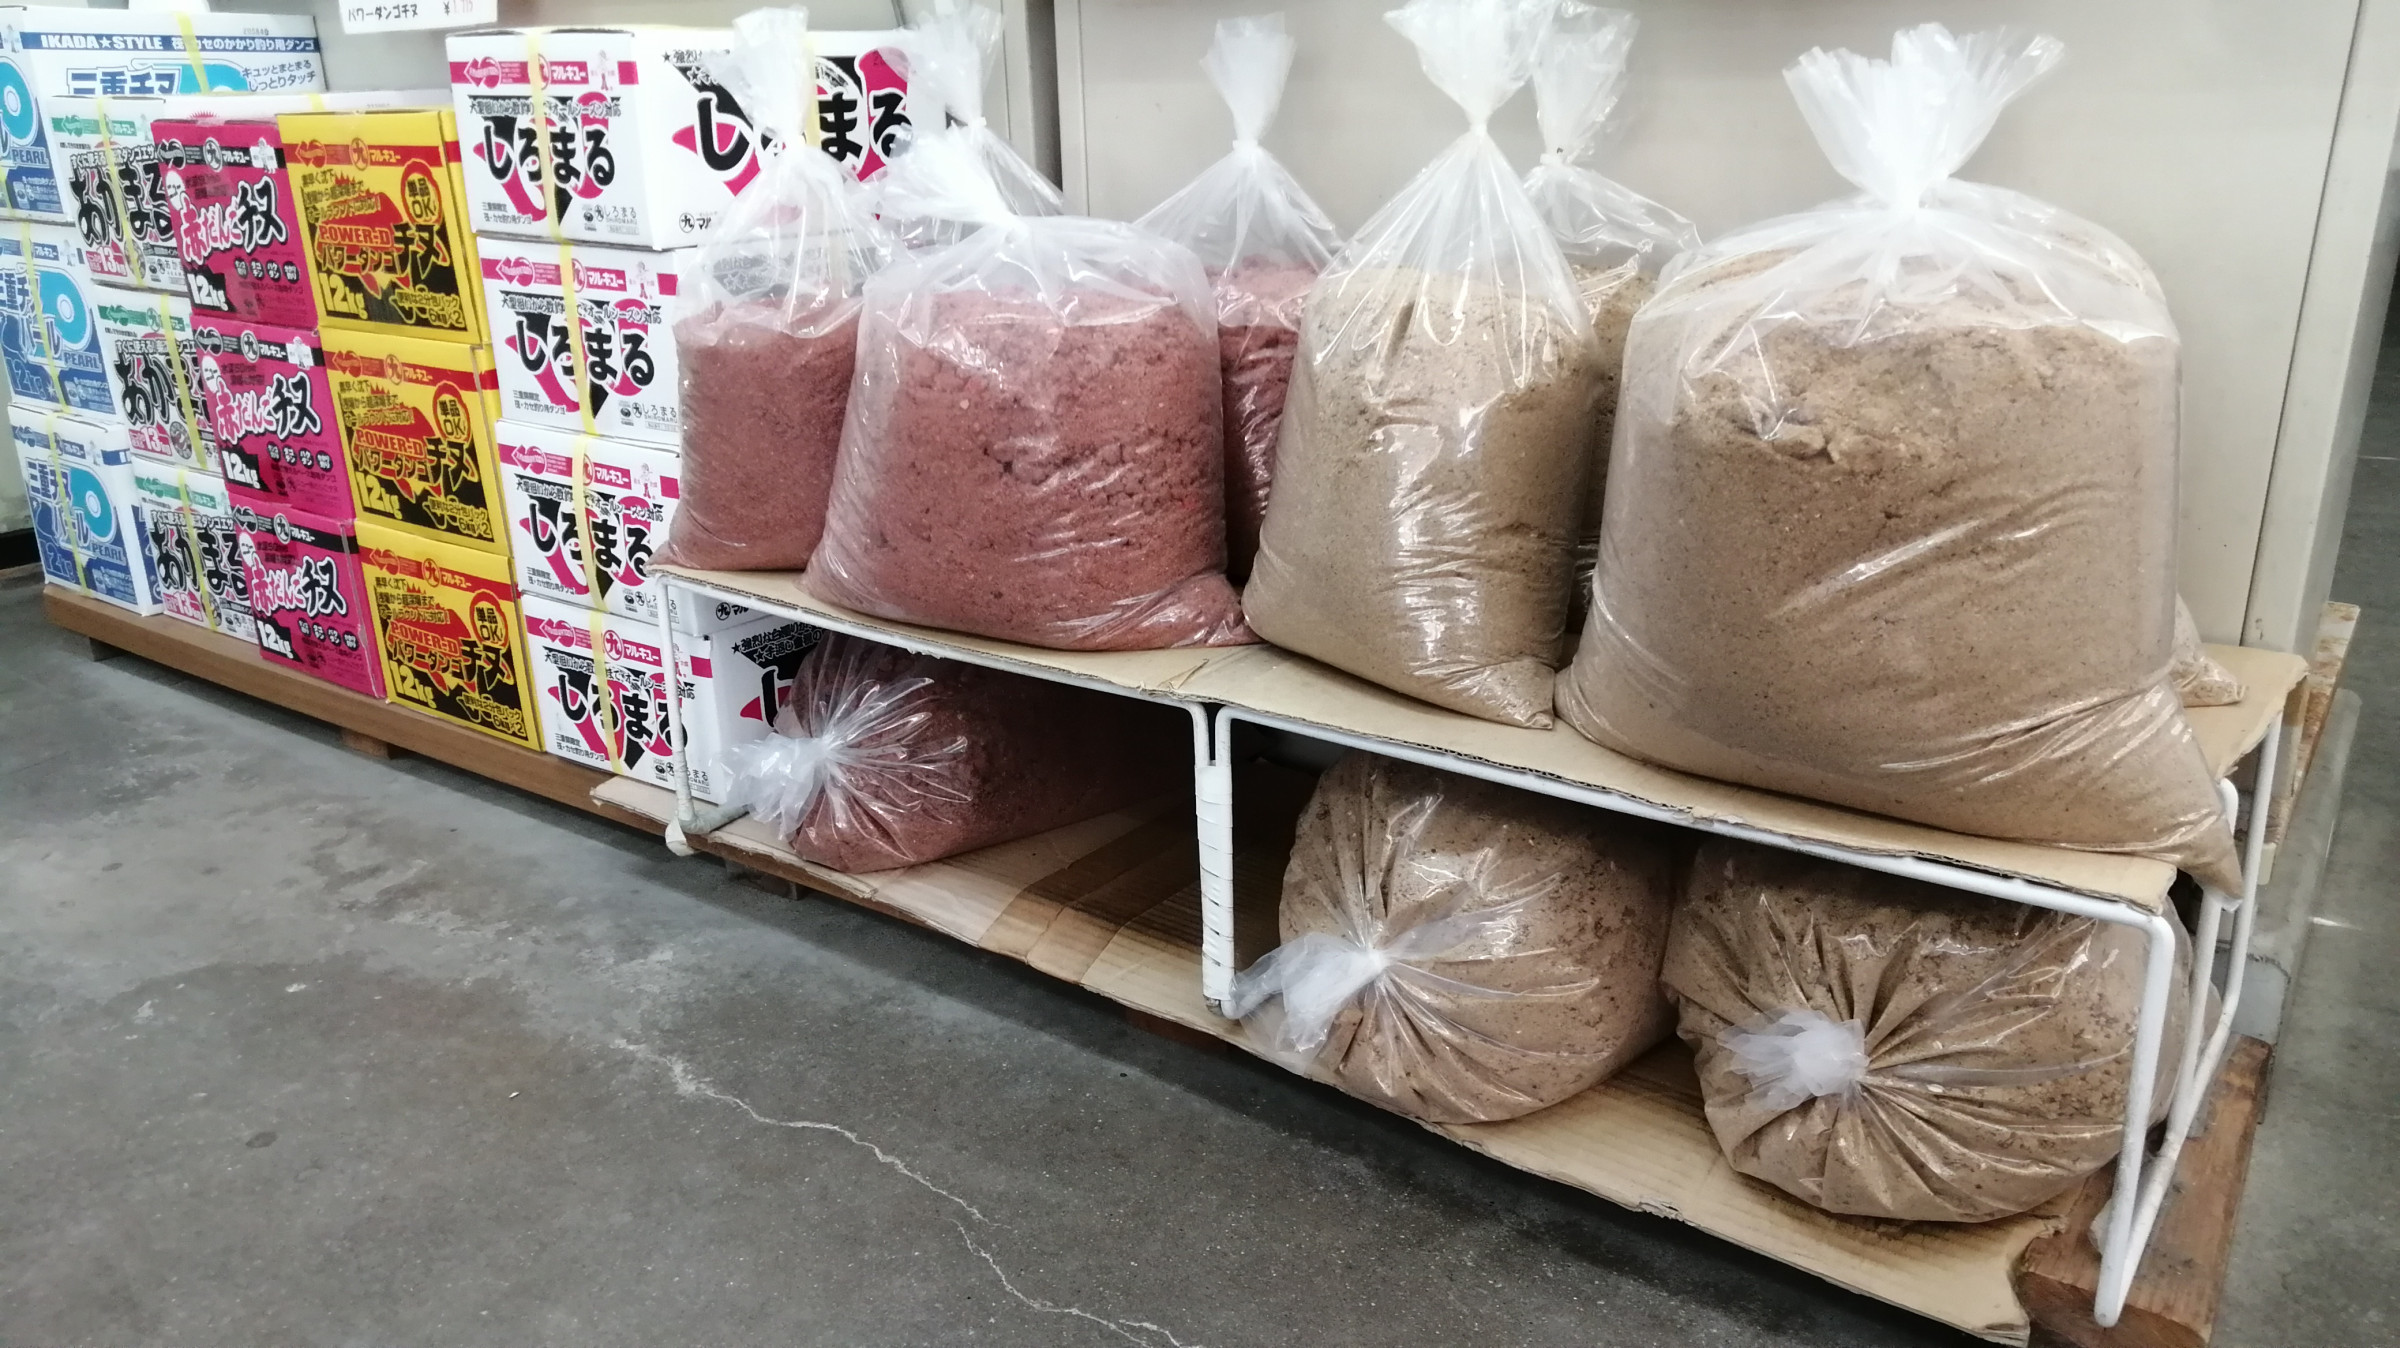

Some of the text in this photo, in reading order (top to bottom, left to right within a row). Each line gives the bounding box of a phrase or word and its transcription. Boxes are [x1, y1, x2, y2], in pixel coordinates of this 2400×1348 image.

[349, 4, 418, 21] パワーダンゴチヌ
[242, 60, 312, 79] キュッとまとまる
[250, 71, 316, 92] しっとりタッチ
[696, 92, 912, 171] しまる
[12, 149, 47, 165] PEARL
[484, 126, 615, 187] しろまる
[187, 273, 229, 312] 12kg
[319, 273, 368, 320] 12kg
[64, 352, 100, 369] PEARL
[517, 321, 655, 387] しろまる
[221, 450, 261, 490] 12kg
[355, 471, 403, 520] 12kg
[92, 542, 125, 562] PEARL
[530, 503, 653, 578] しろまる
[257, 619, 294, 659] 12kg
[390, 660, 437, 709] 12kg
